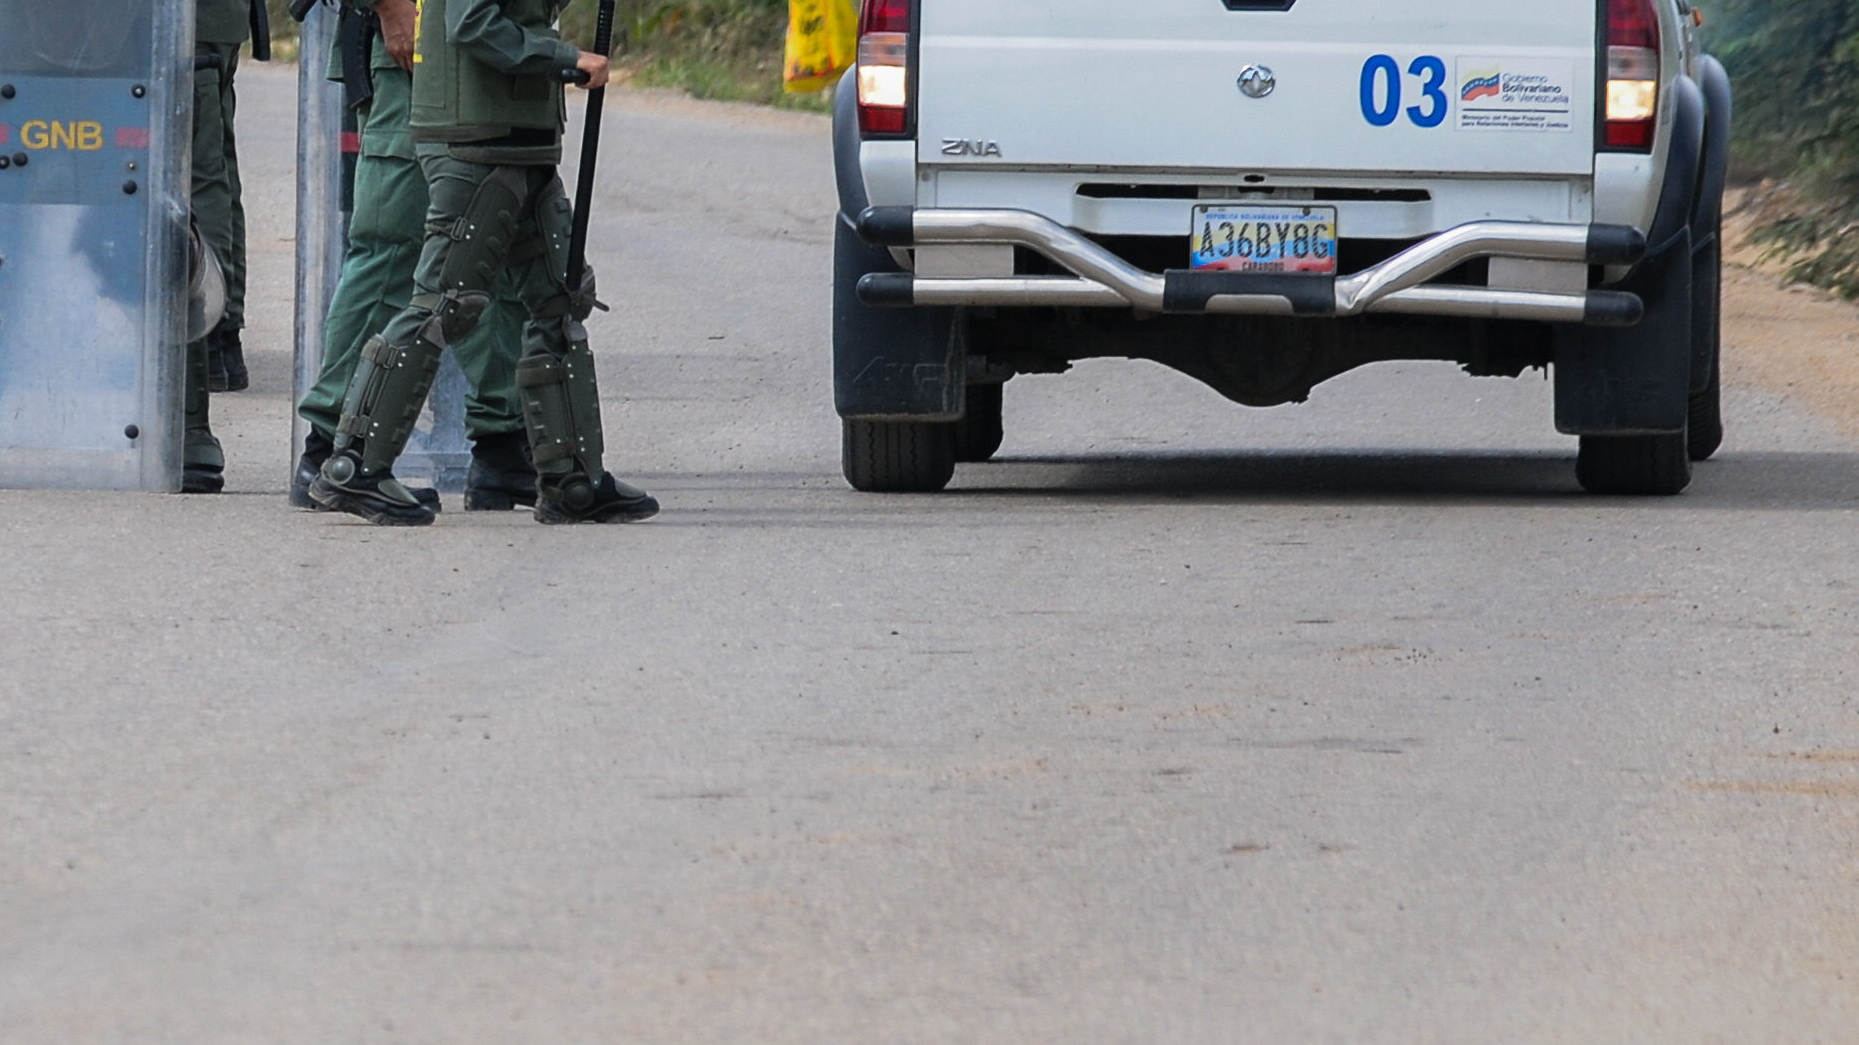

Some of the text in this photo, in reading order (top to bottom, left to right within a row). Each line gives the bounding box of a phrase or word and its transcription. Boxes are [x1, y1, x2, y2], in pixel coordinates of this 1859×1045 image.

[1502, 73, 1548, 83] Gobierno
[1360, 54, 1448, 128] 03
[1502, 83, 1562, 94] Bolivariano
[1502, 94, 1569, 103] de Venezuela
[20, 119, 104, 150] GNB
[942, 138, 1002, 157] ZNA
[1199, 221, 1329, 259] A36BY8G
